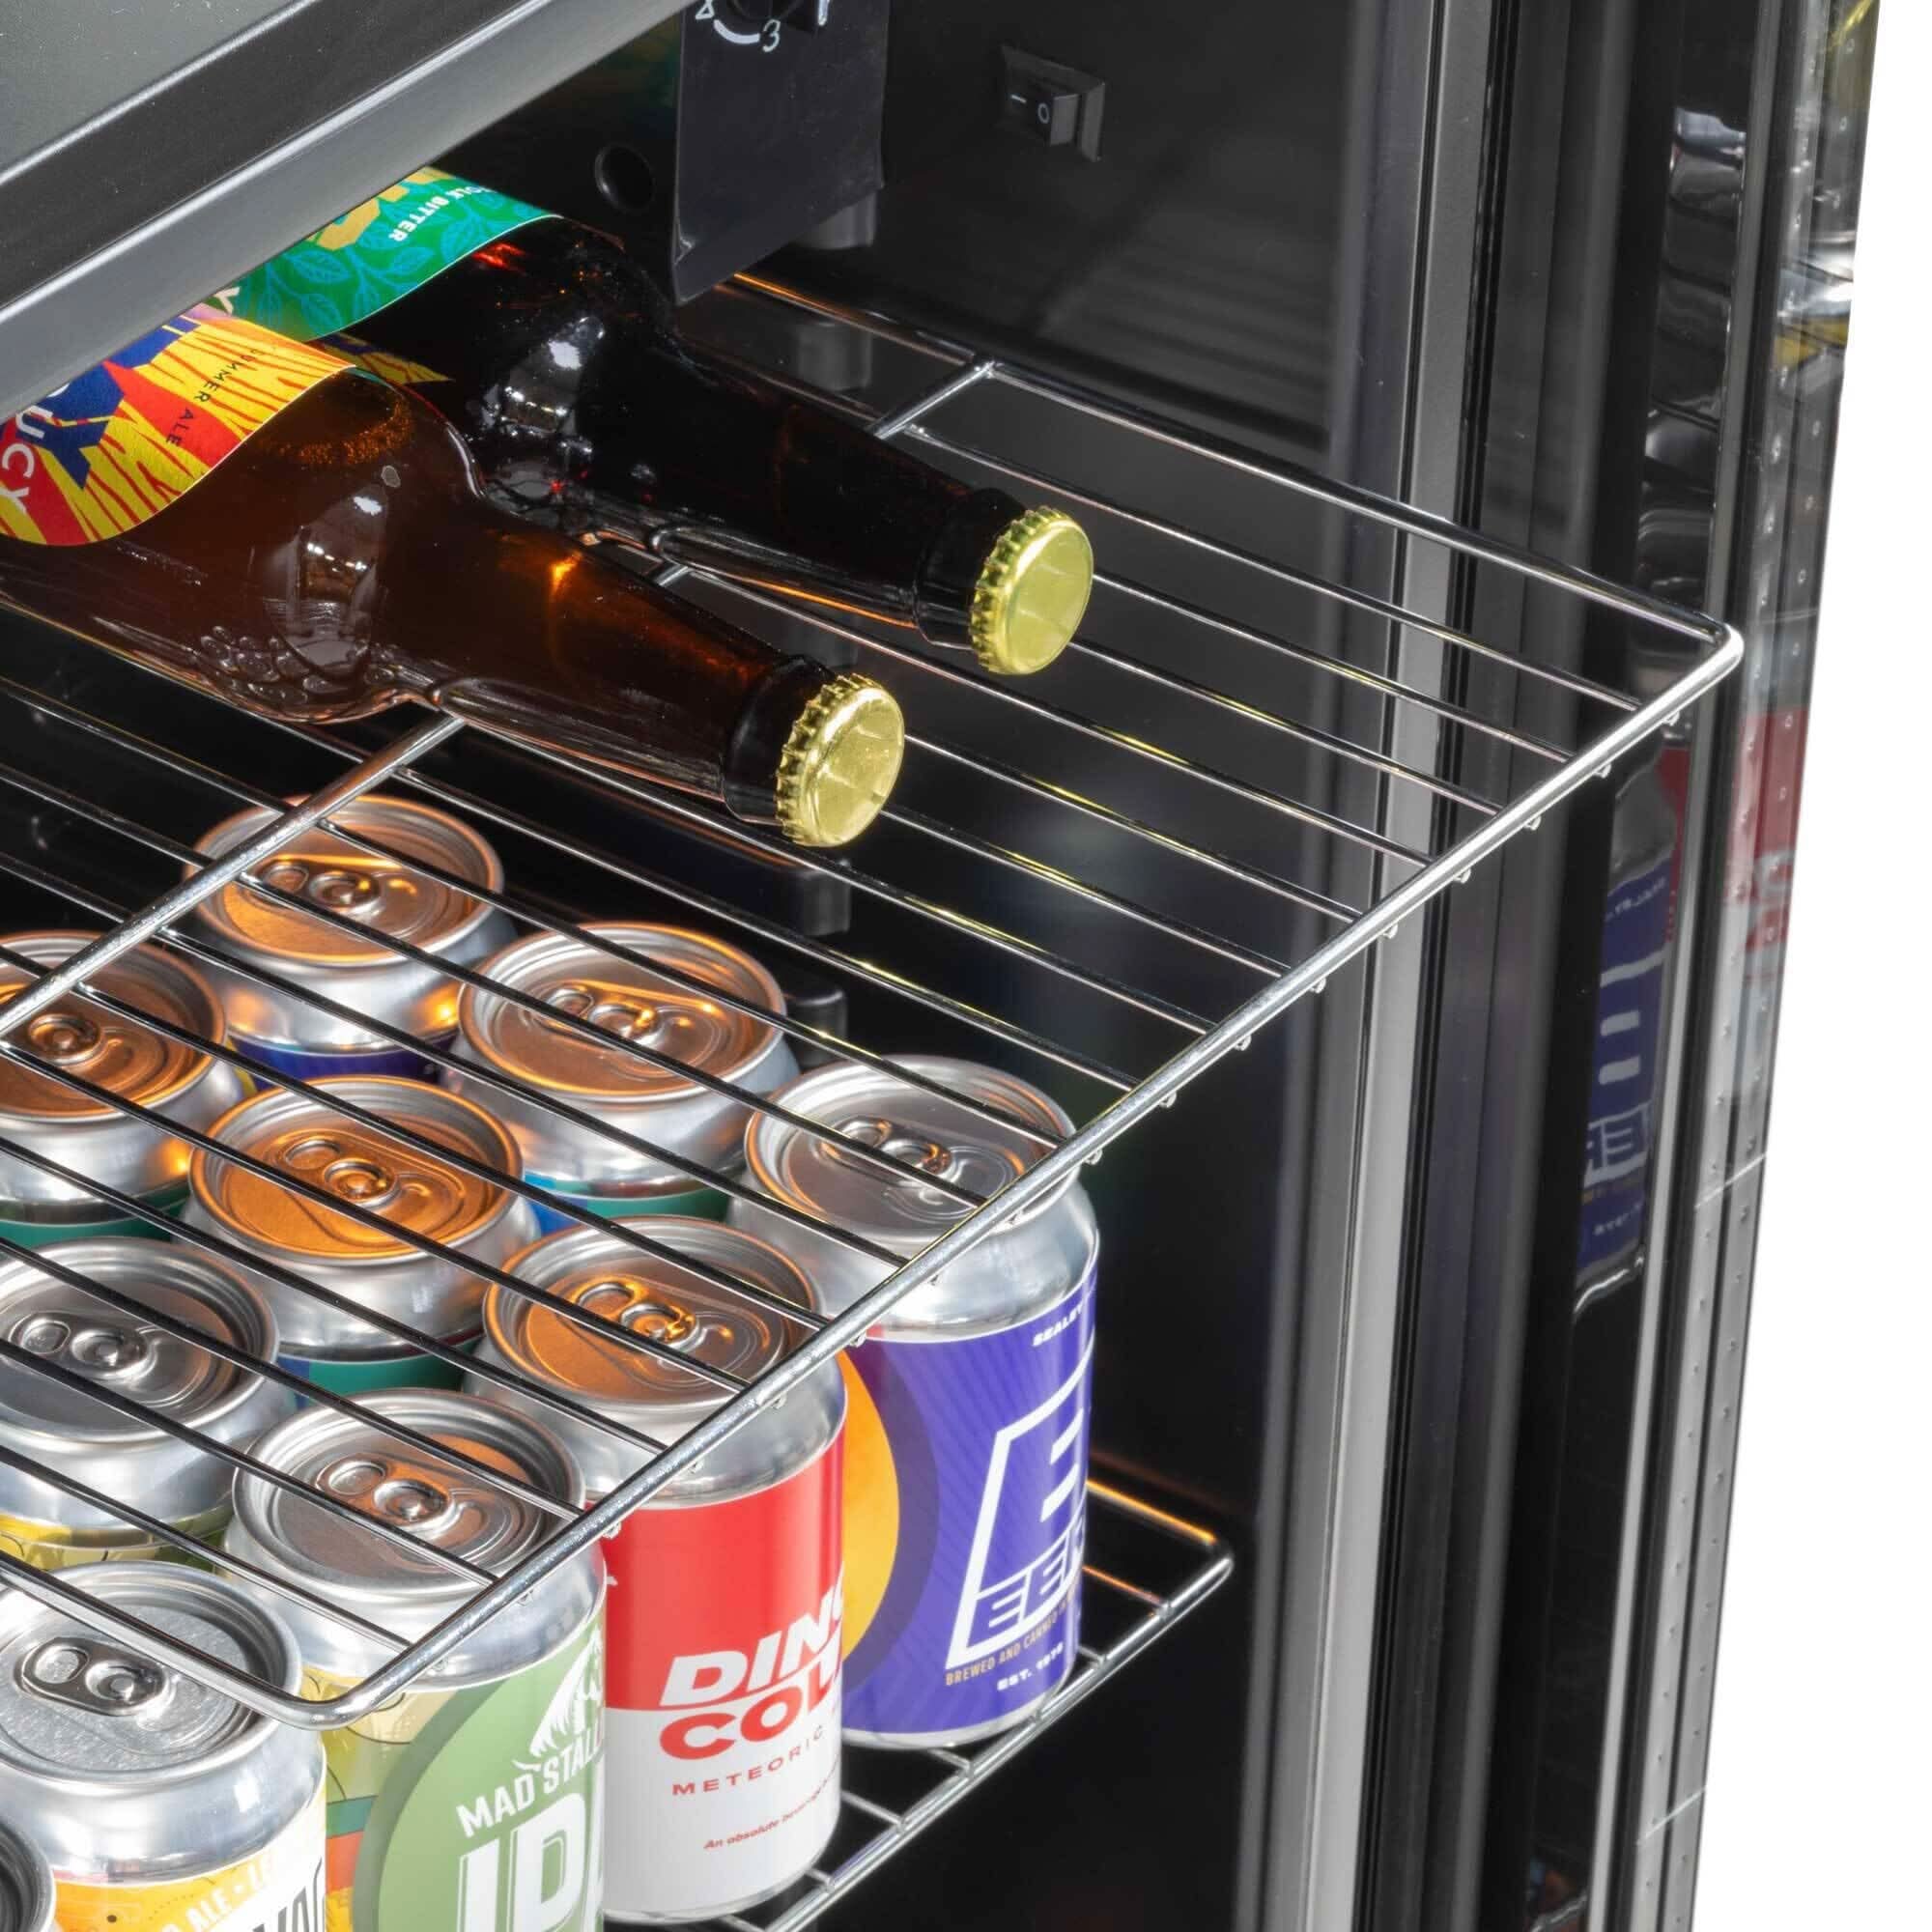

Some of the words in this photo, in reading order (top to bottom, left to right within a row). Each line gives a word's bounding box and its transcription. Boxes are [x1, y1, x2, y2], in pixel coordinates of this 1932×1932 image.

[762, 19, 781, 52] 3
[388, 196, 450, 242] BITTER
[165, 408, 195, 446] ALE
[945, 1657, 996, 1687] BREWED
[999, 1643, 1021, 1663] AND
[659, 1663, 838, 1760] COL
[455, 1773, 535, 1838] MAD
